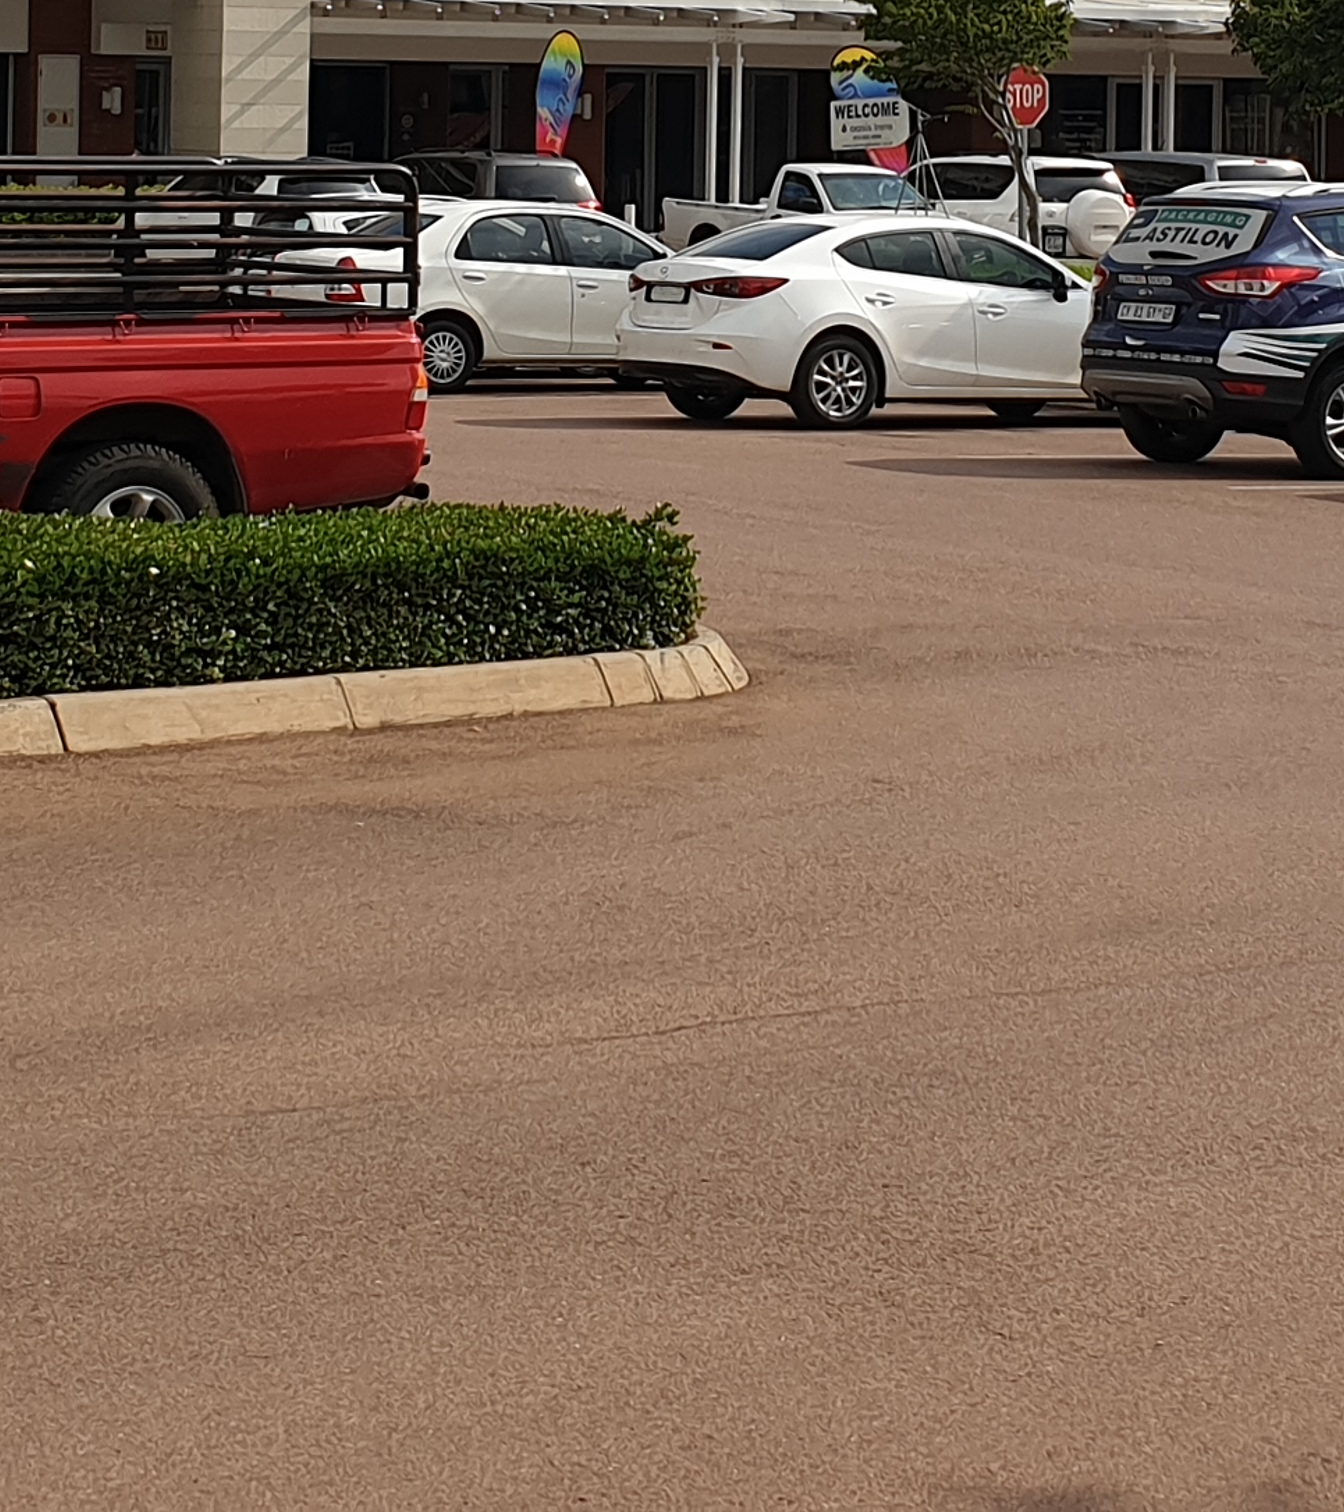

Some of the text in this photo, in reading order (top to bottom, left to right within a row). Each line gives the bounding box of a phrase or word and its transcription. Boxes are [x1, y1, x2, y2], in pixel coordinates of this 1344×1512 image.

[1006, 83, 1043, 109] STOP
[834, 101, 900, 120] WELCOME
[1159, 210, 1247, 226] PACKAGING
